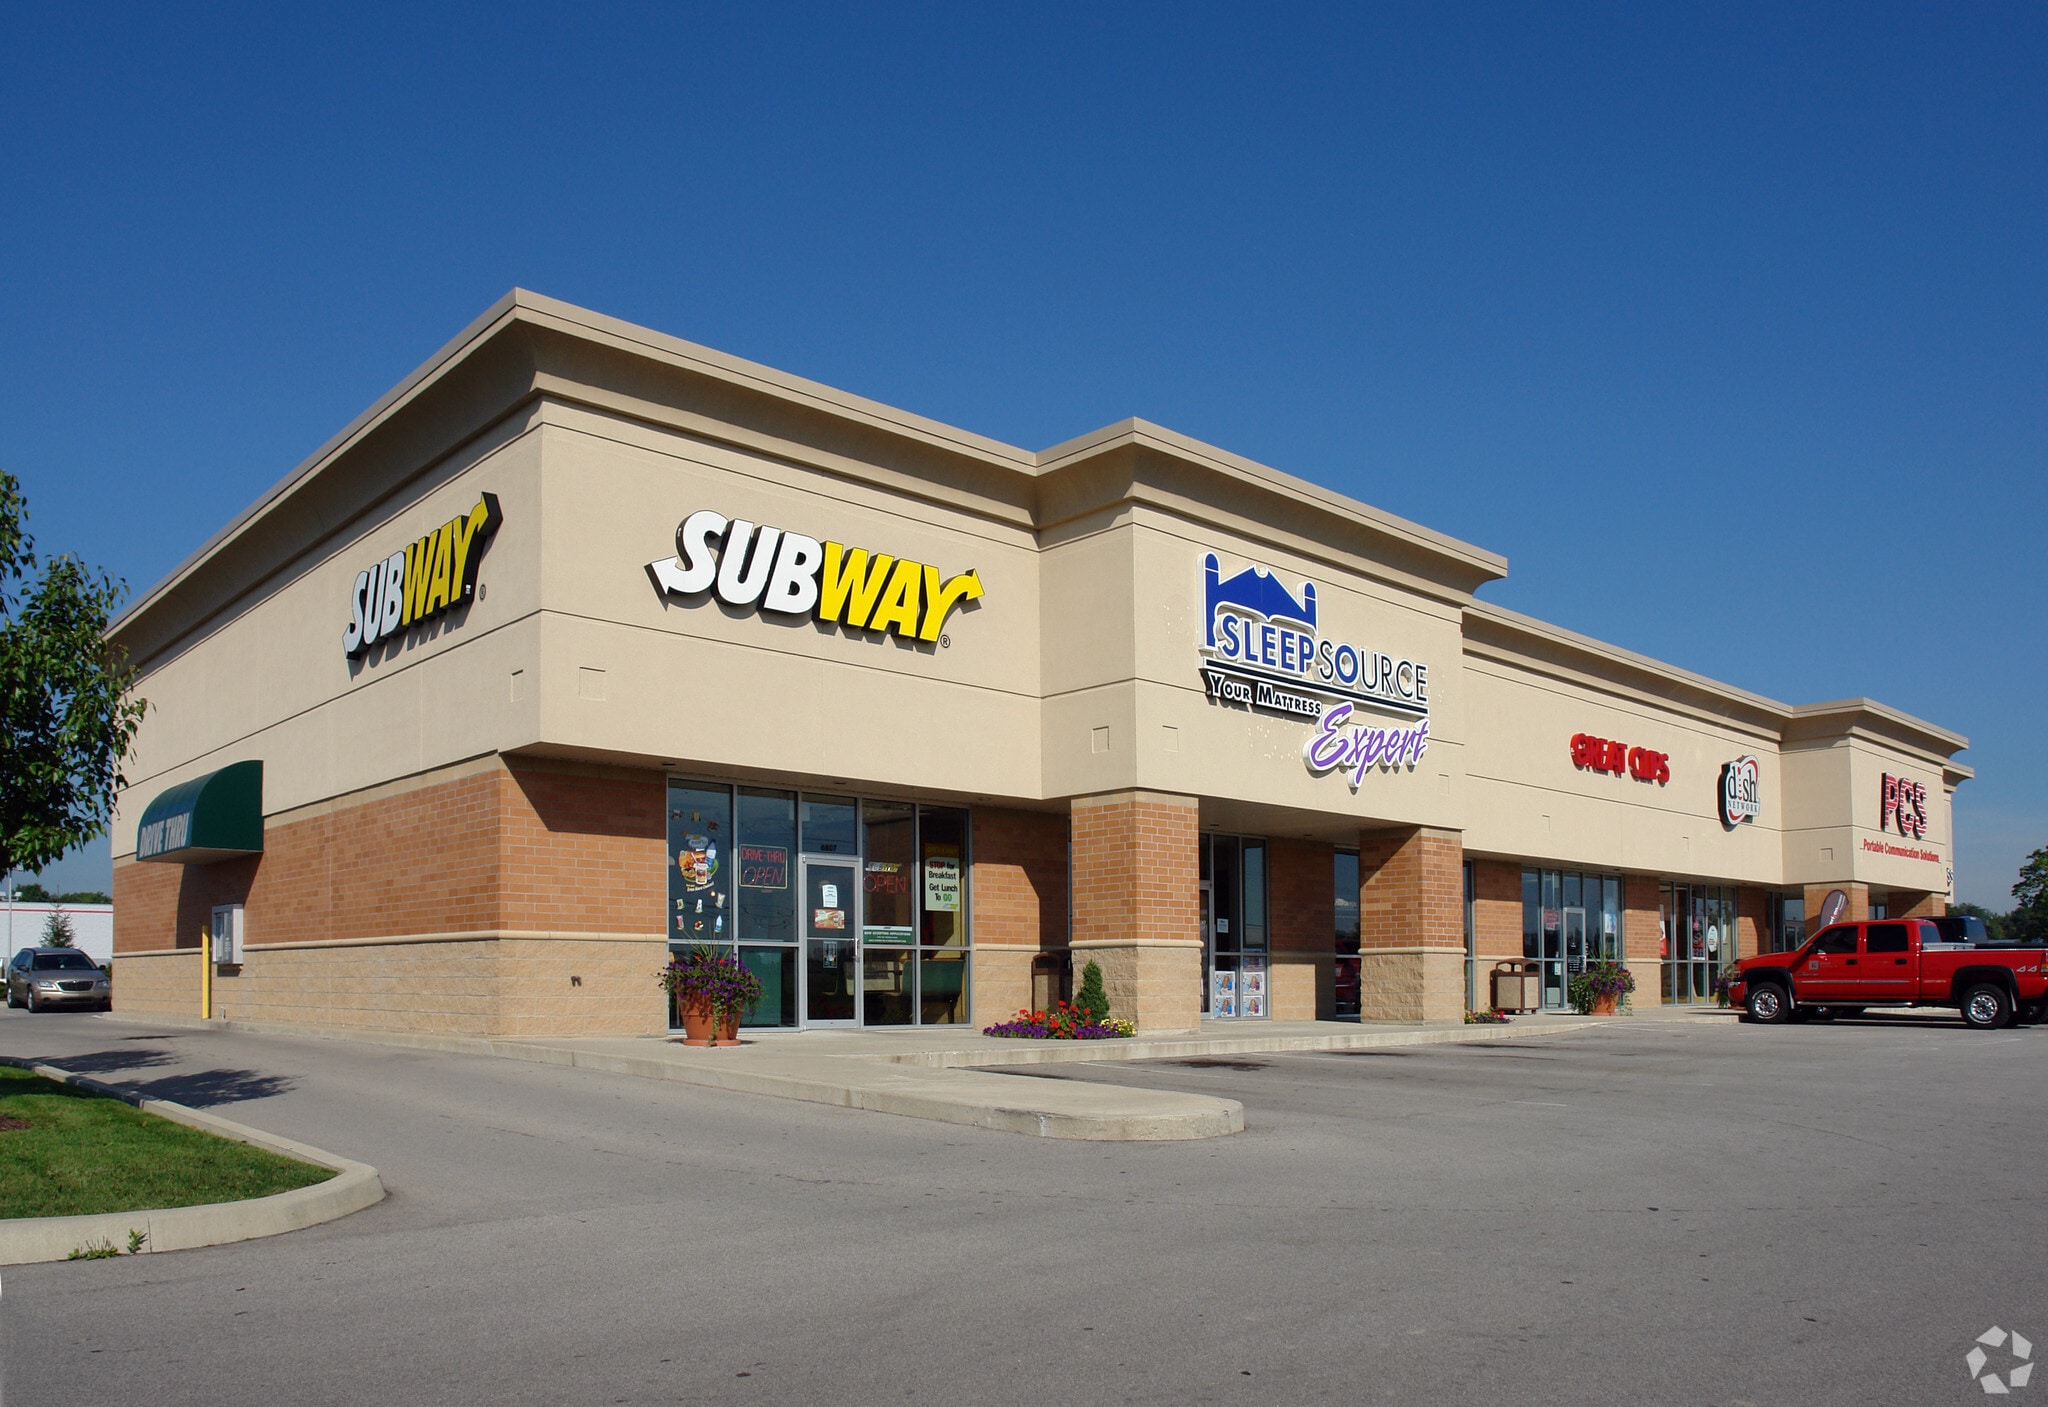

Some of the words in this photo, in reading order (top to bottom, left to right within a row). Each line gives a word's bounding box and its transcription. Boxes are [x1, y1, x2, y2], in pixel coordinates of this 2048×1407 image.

[342, 491, 500, 656] SUBWAY
[648, 509, 986, 643] SUBWAY
[1221, 613, 1315, 674] SLEEP
[1318, 639, 1428, 704] SOURCE
[1307, 701, 1429, 788] Expert
[1570, 733, 1628, 774] GREAT
[1727, 765, 1758, 803] dish
[1727, 800, 1758, 813] NETWORK
[1881, 772, 1927, 838] PCS
[139, 819, 165, 858] DRIVE
[164, 812, 190, 851] THRU
[1863, 838, 1884, 854] Portable
[1884, 842, 1920, 860] Communication
[1920, 849, 1940, 863] Solutions
[741, 846, 786, 864] DRIVE-THRU
[742, 865, 786, 886] OPEN
[863, 873, 907, 894] OPEN
[928, 870, 957, 880] Breakfast
[929, 883, 940, 892] Get
[941, 883, 958, 892] Lunch
[935, 893, 941, 901] To
[942, 893, 953, 902] GO
